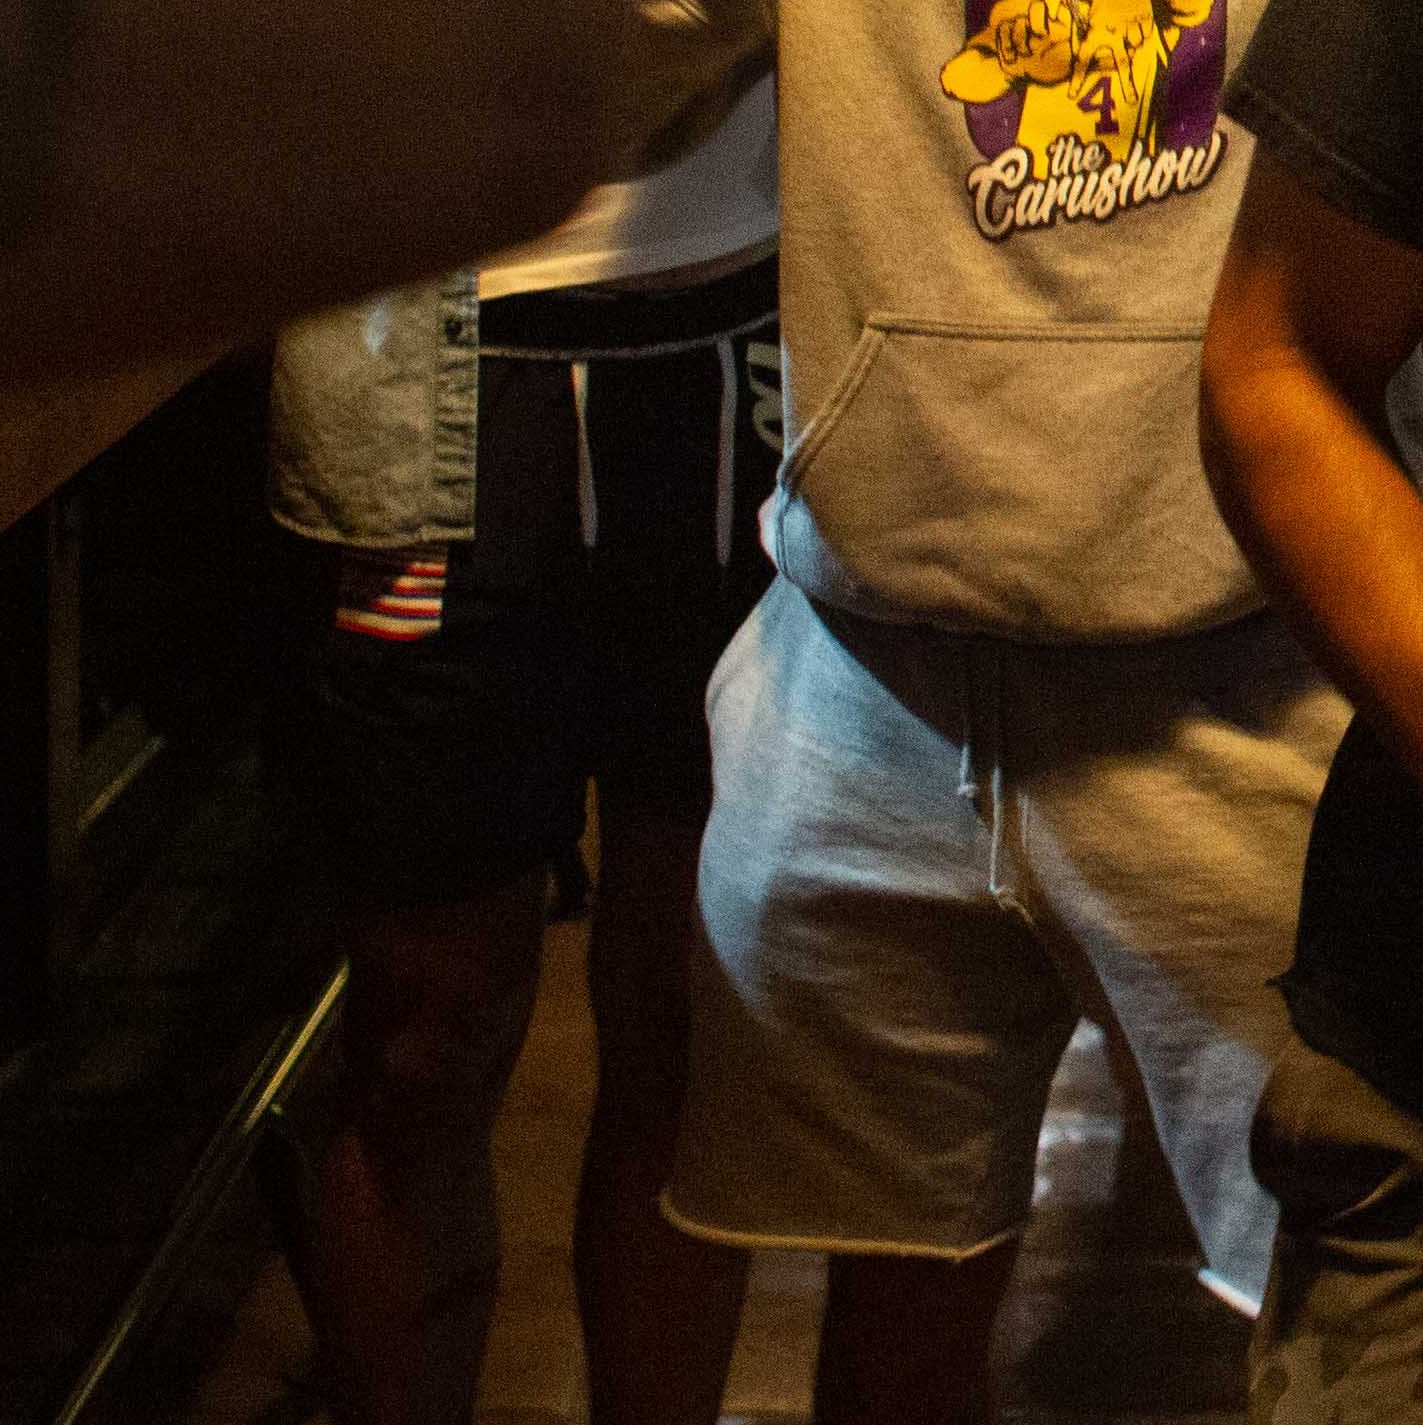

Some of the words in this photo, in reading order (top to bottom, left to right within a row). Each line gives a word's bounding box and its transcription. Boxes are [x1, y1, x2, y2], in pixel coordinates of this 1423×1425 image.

[1078, 76, 1121, 136] 4
[968, 134, 1222, 237] Carushow
[1048, 133, 1105, 179] the
